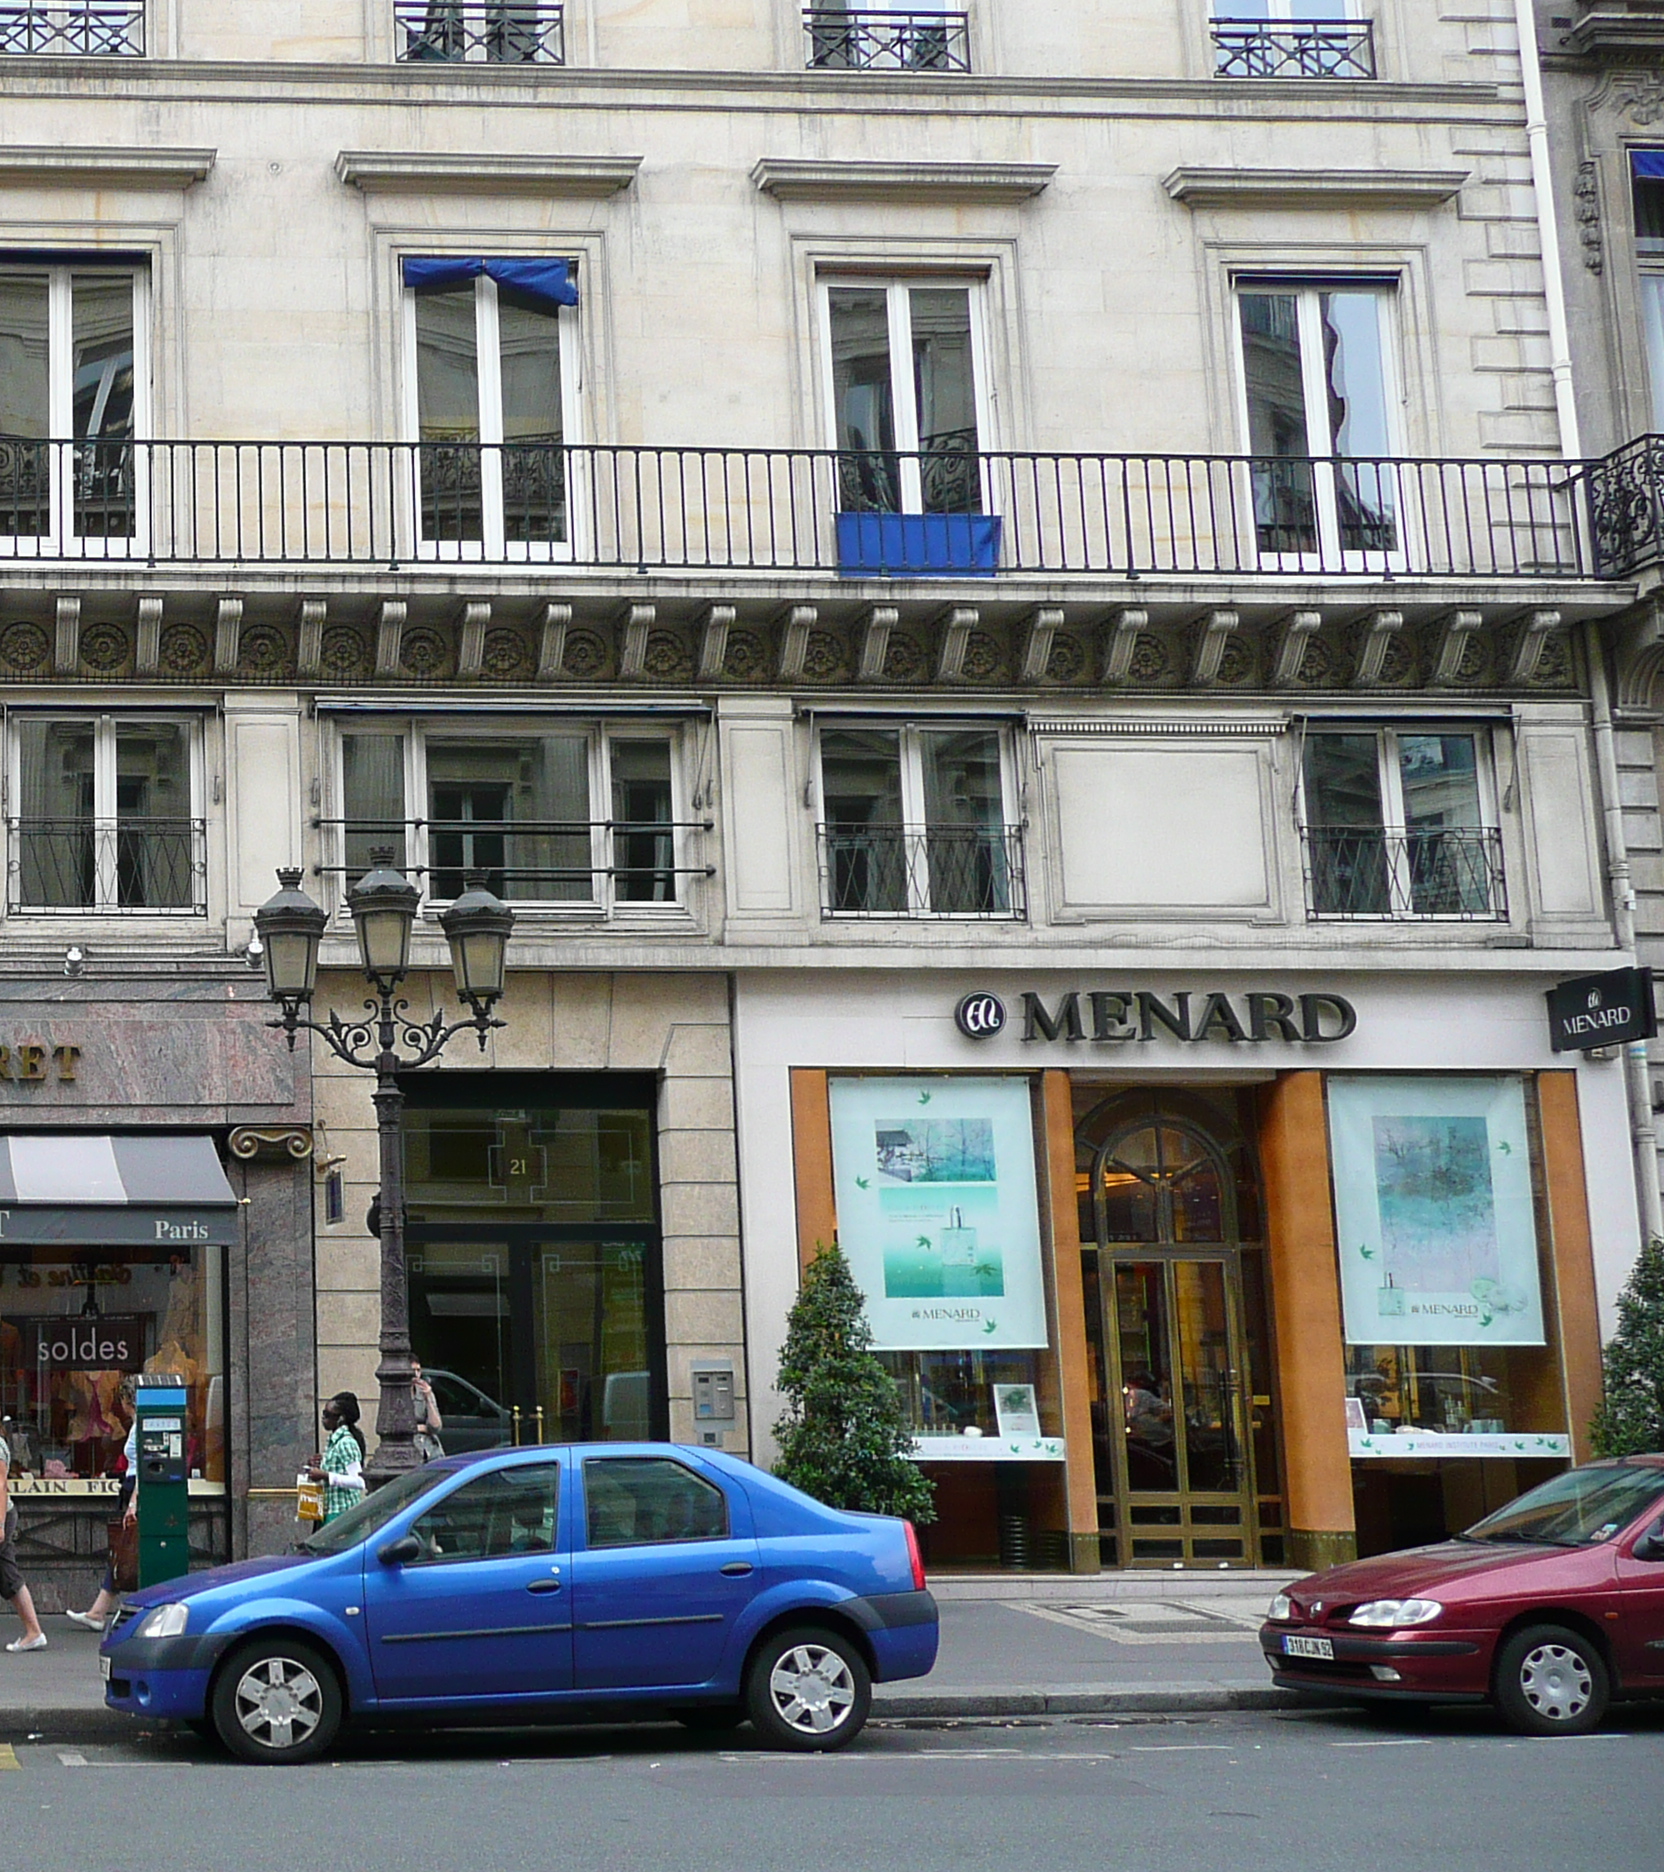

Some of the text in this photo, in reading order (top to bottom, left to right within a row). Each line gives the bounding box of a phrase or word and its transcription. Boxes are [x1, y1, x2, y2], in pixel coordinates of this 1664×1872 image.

[1020, 991, 1358, 1043] MENARD
[1563, 1006, 1631, 1035] MENARD
[510, 1159, 526, 1175] 21
[155, 1220, 208, 1239] Paris
[923, 1308, 980, 1319] MENARD
[1422, 1304, 1478, 1314] MENARD
[38, 1327, 128, 1360] soldes
[5, 1481, 67, 1493] LAIN
